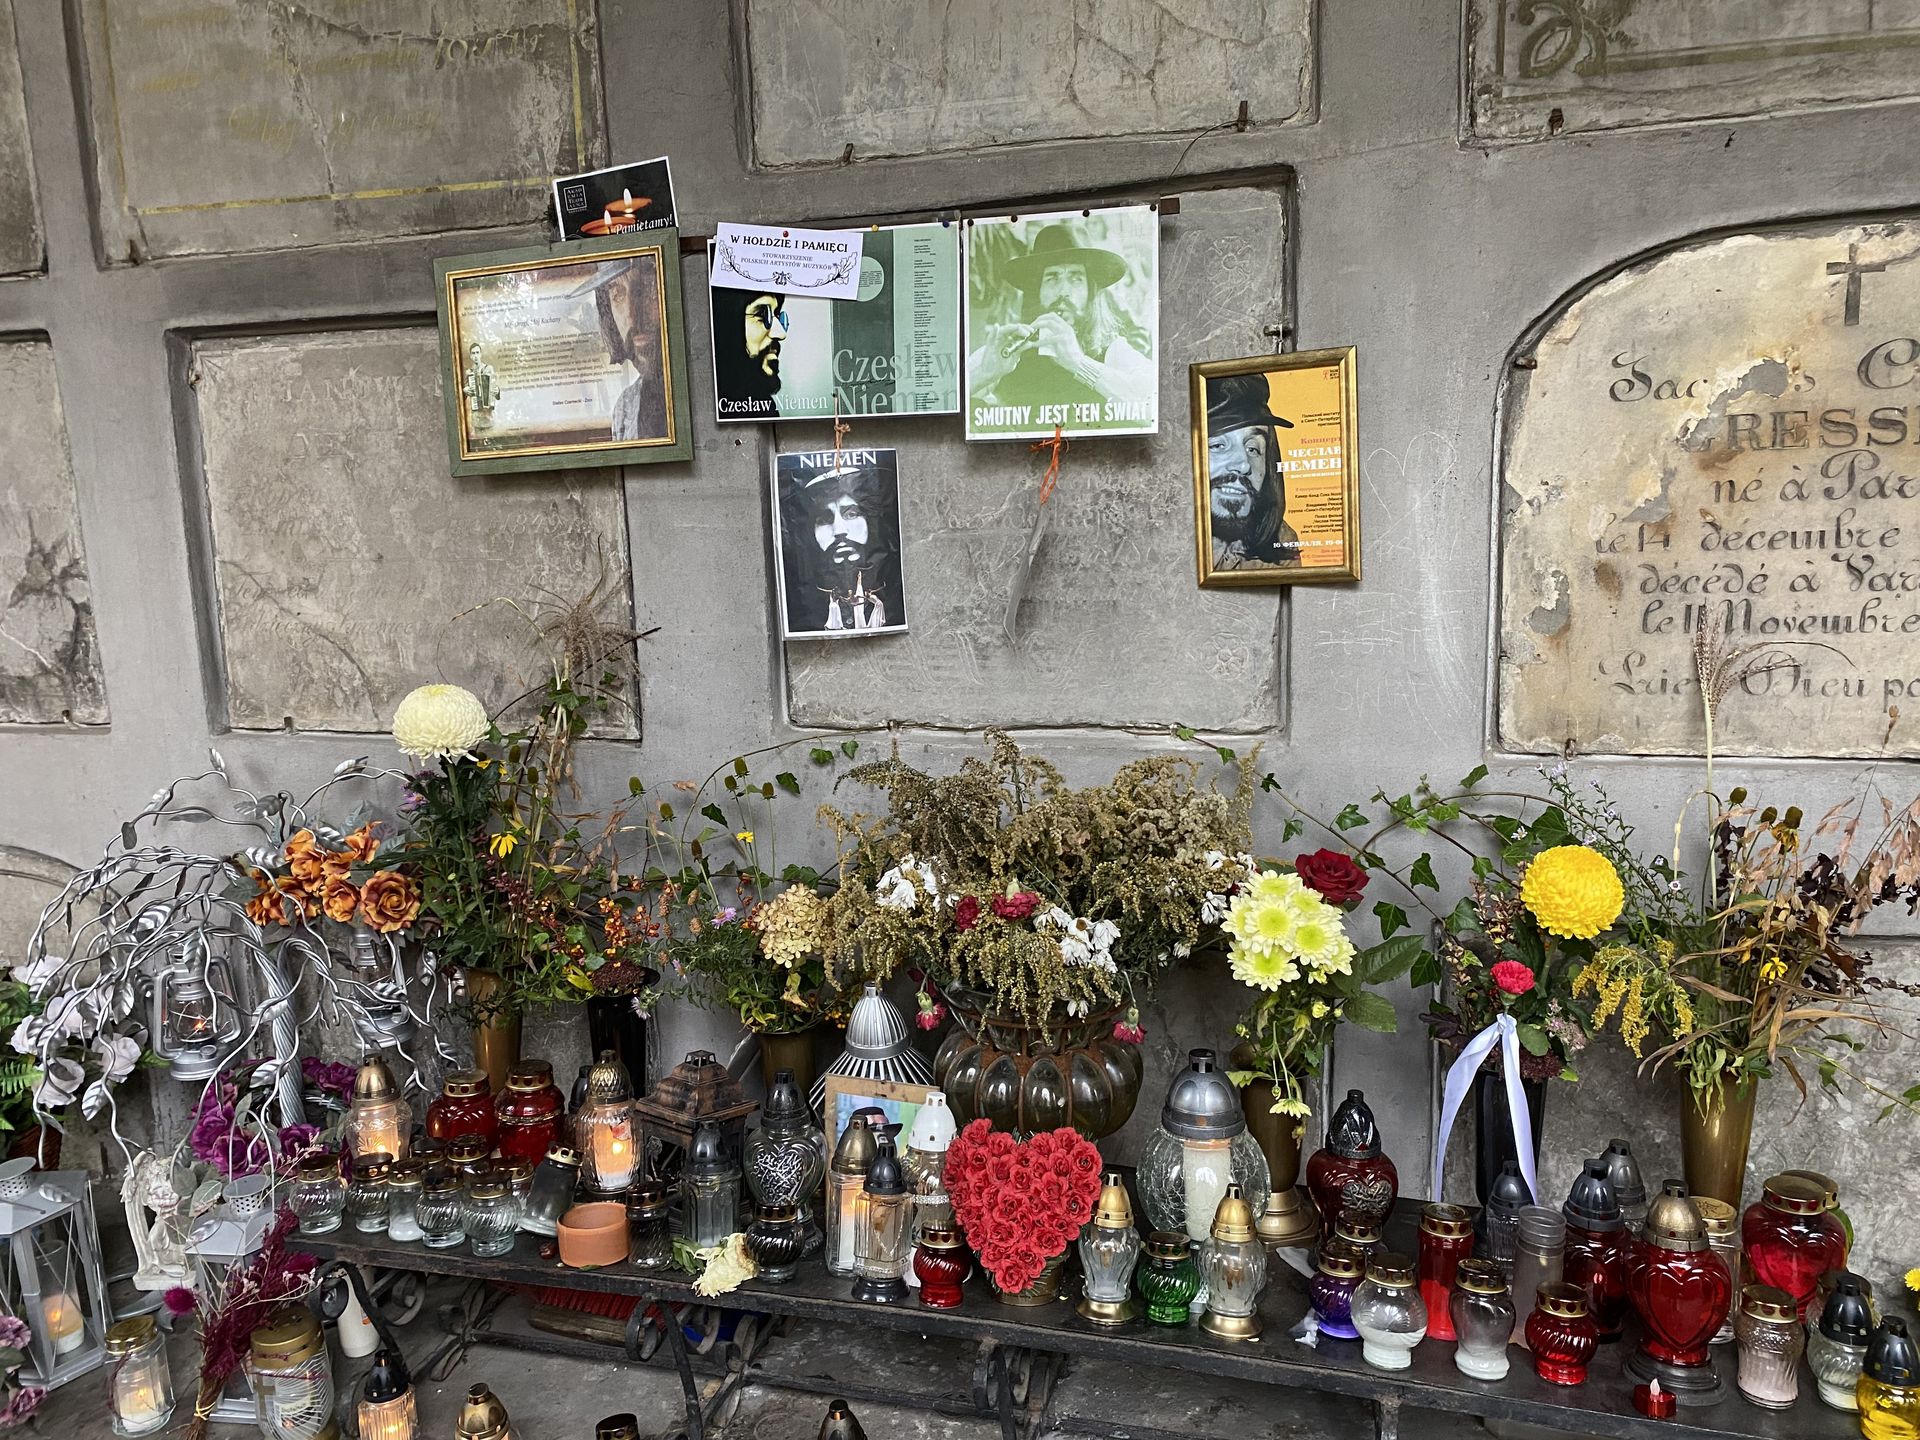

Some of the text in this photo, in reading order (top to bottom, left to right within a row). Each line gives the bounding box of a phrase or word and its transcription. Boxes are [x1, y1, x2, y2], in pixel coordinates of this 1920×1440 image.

[730, 235, 848, 254] W HOŁDZIE I PAMIĘCI
[741, 257, 832, 271] POLSKICH ARTYSTÓW MUZYKÓW
[762, 252, 814, 262] STOWARZYSZENIE
[1609, 351, 1816, 402] Jacs
[718, 394, 828, 414] Czesław Niemen
[974, 406, 1031, 427] SMUTNY
[1035, 404, 1069, 425] JEST
[1073, 402, 1100, 423] TEN
[800, 450, 877, 468] NIEMEN
[1288, 446, 1342, 458] ЧЕСЛАВ
[1276, 458, 1342, 473] НЕМЕН
[1710, 467, 1764, 504] né
[1779, 465, 1811, 503] à
[1638, 563, 1769, 595] décédé
[1789, 560, 1820, 593] à
[1642, 599, 1675, 634] le
